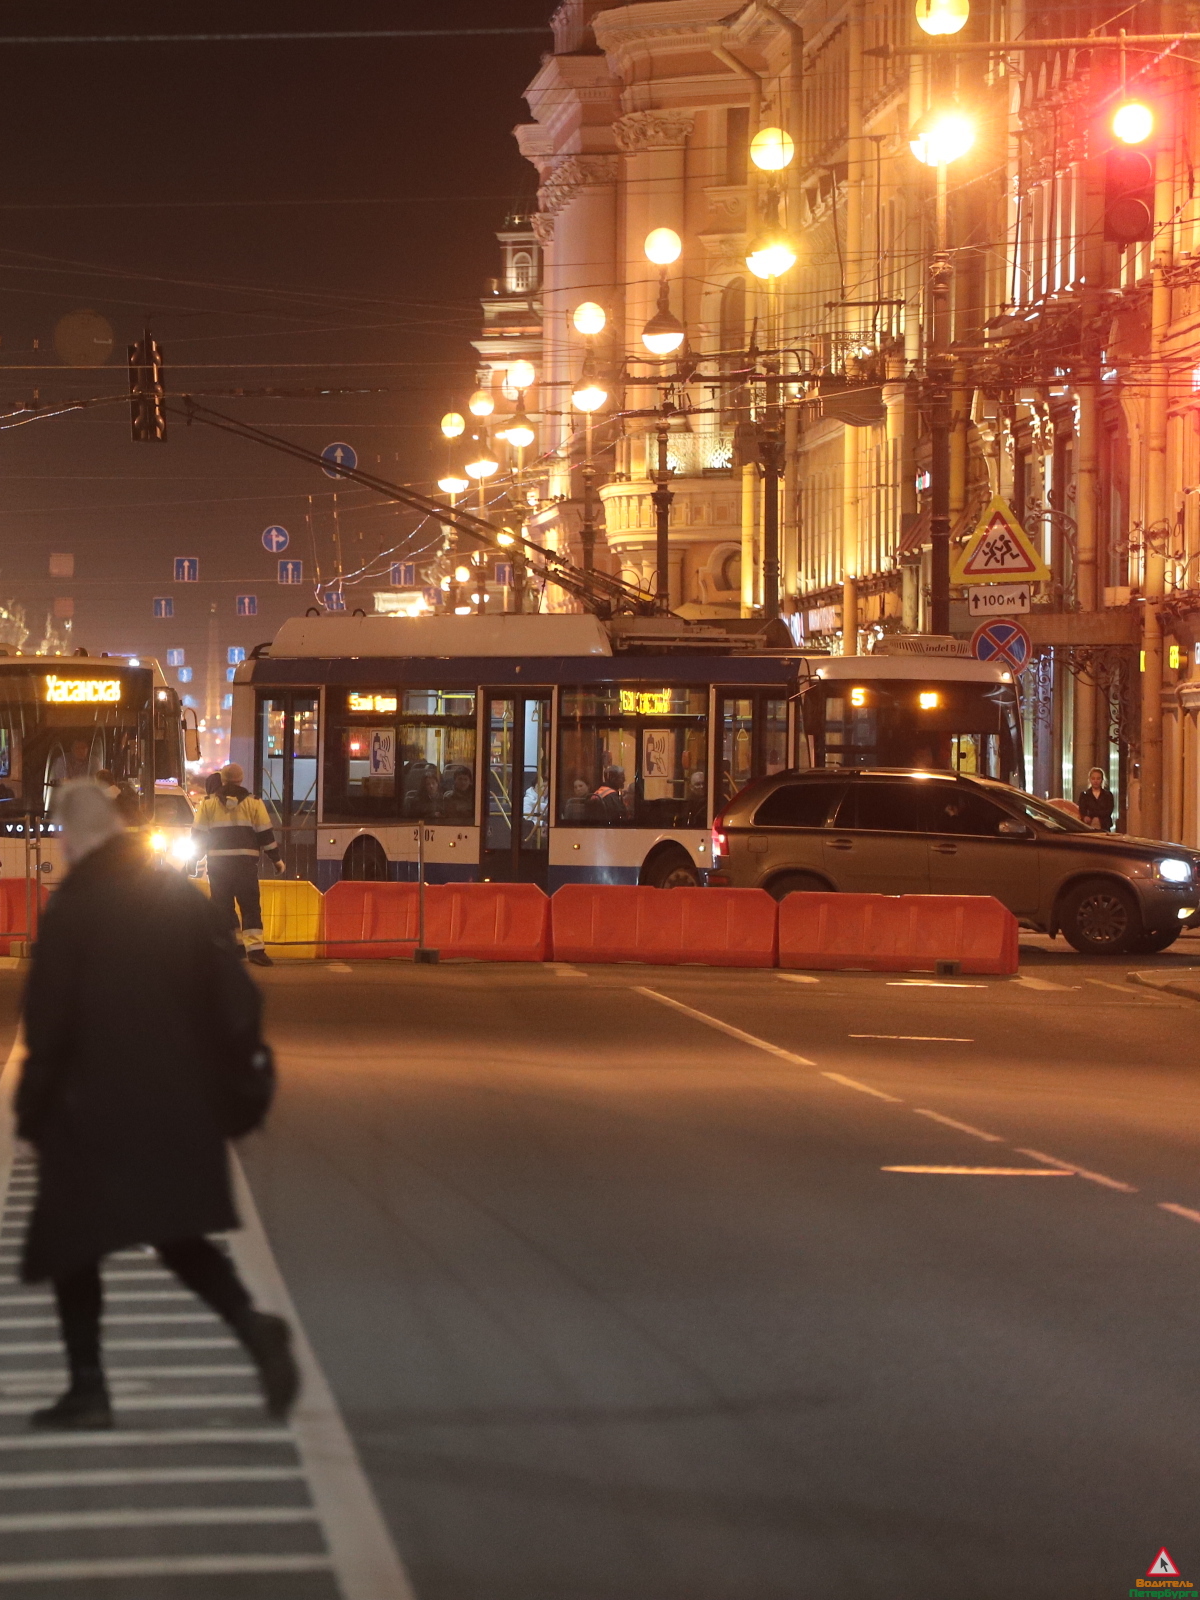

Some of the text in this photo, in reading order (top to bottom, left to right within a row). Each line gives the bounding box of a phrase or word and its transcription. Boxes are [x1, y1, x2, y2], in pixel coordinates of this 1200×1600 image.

[982, 595, 1004, 606] 100
[925, 644, 948, 652] indel
[46, 675, 121, 702] Хасанская
[851, 688, 865, 706] 5
[413, 829, 436, 842] 207
